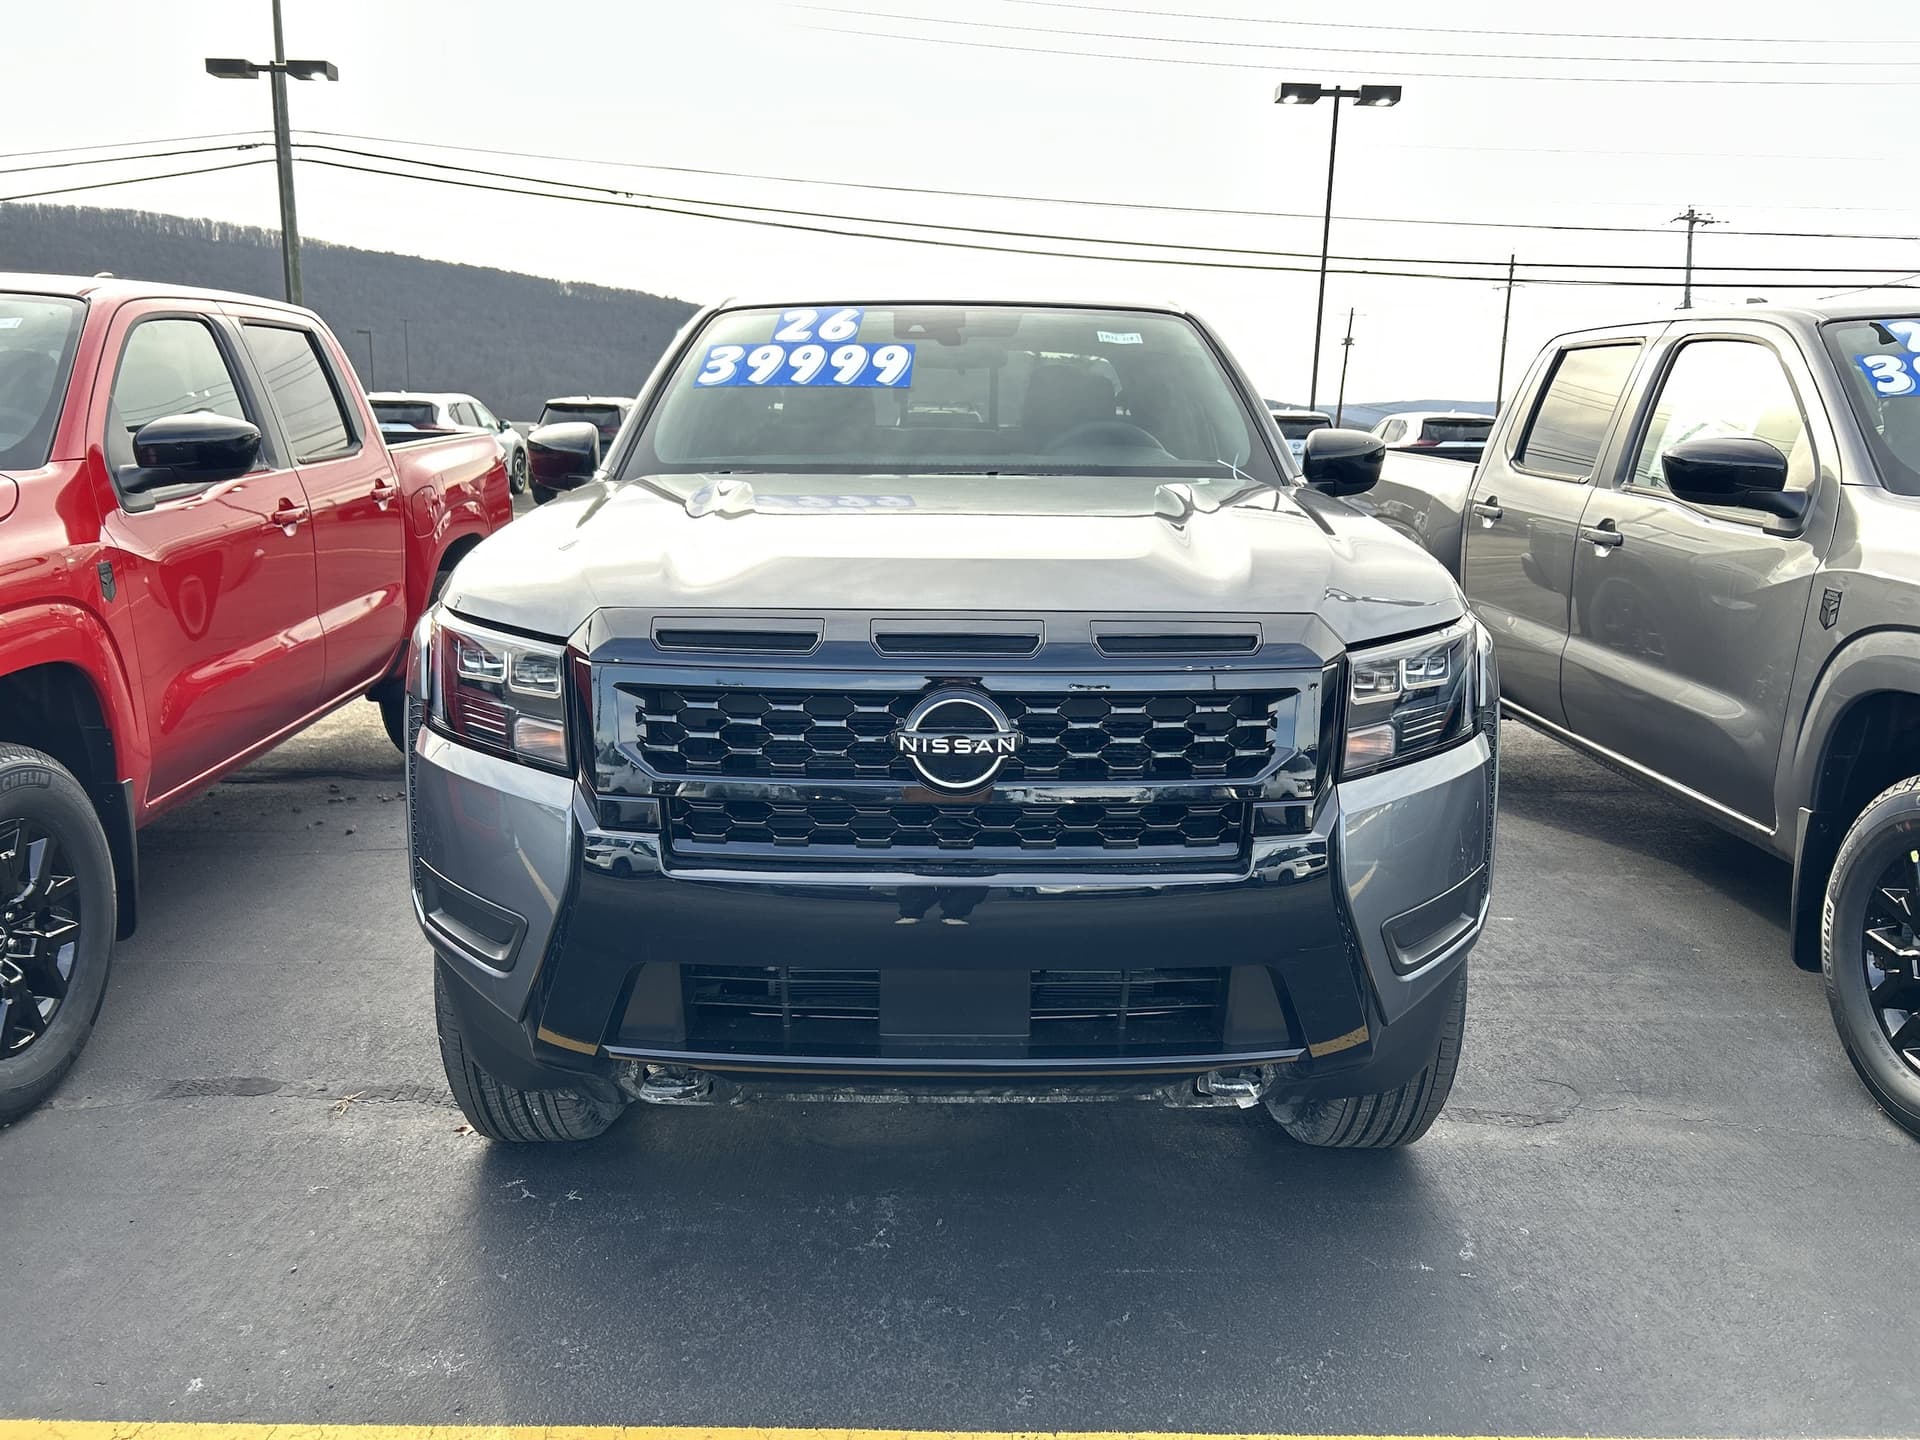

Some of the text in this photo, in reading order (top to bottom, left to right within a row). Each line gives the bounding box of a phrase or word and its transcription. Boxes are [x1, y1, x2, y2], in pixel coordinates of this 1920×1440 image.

[774, 308, 863, 342] 26
[697, 344, 913, 385] 39999
[1863, 354, 1920, 395] 3
[899, 737, 1016, 754] NISSAN
[1821, 903, 1839, 998] ICHELIN
